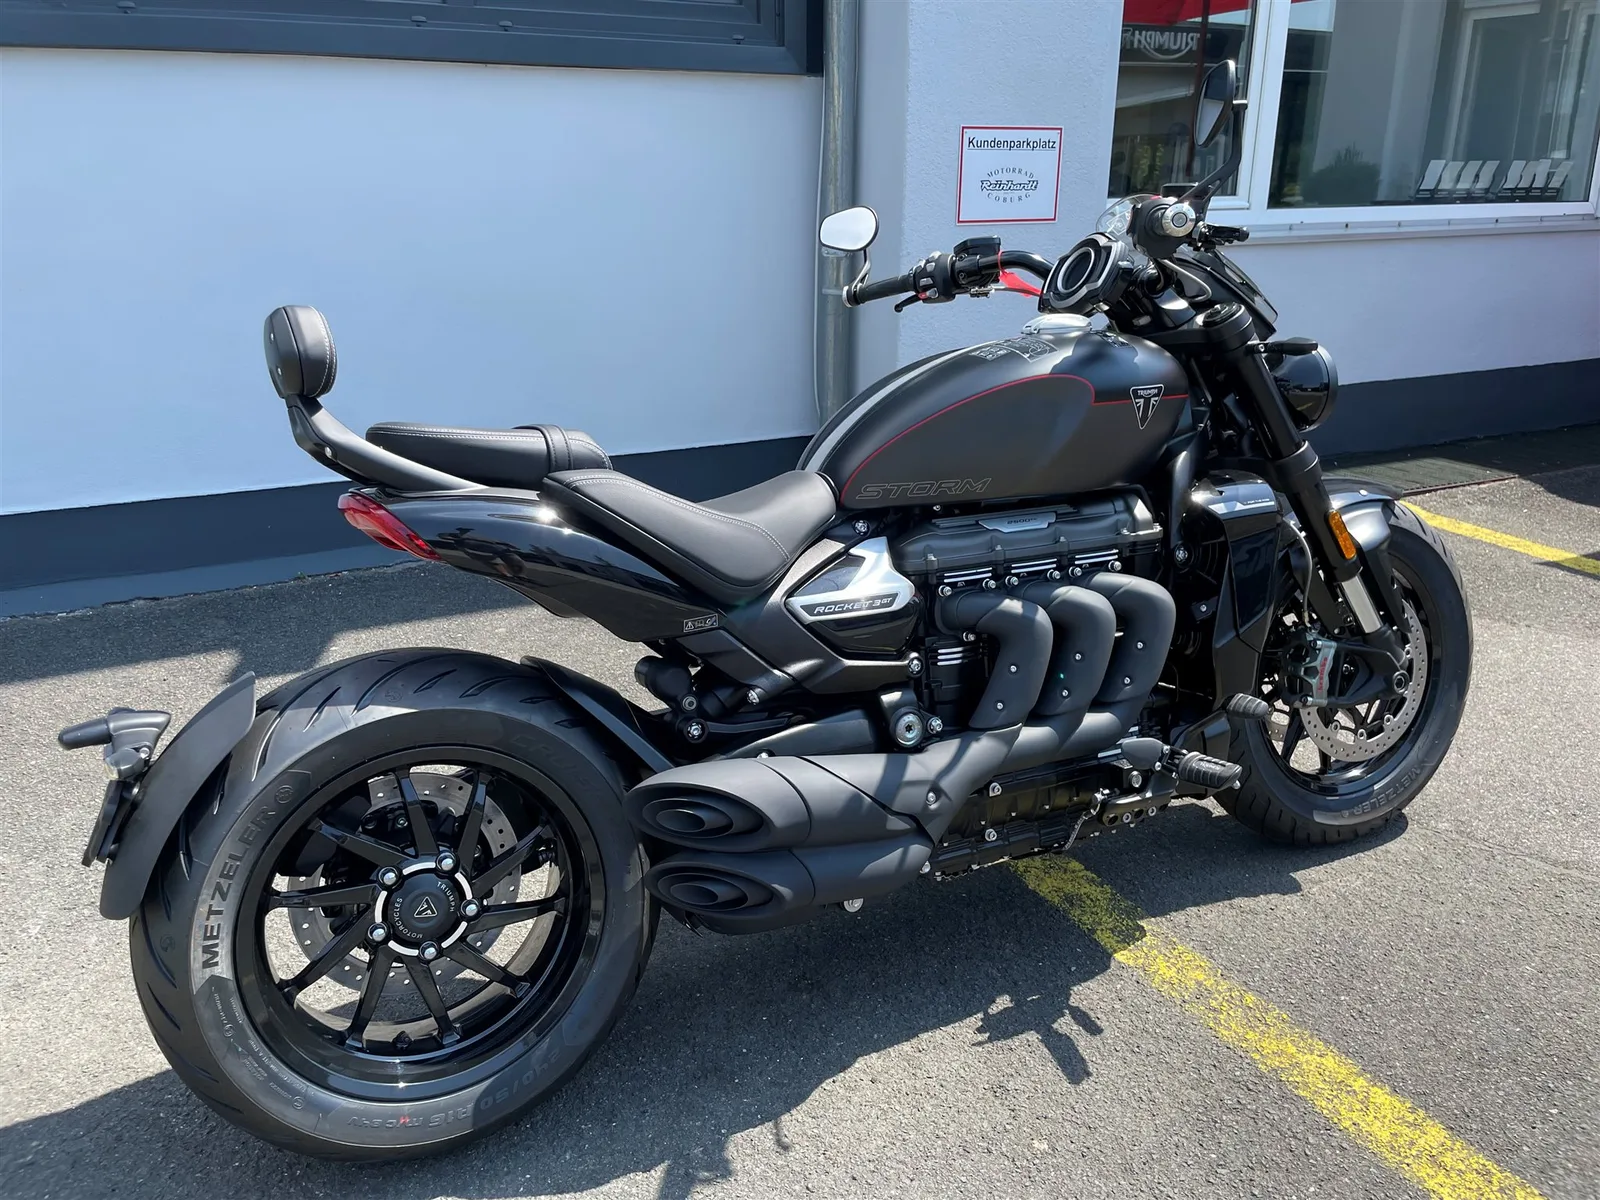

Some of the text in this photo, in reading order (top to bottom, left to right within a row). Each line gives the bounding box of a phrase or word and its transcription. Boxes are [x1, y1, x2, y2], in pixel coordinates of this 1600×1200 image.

[968, 136, 1056, 151] Kundenparkplatz
[987, 167, 1035, 179] MOTORRAD
[980, 179, 1039, 192] Reinhardt
[987, 192, 1031, 203] COBURG
[855, 478, 992, 500] STORM
[813, 600, 873, 614] ROCKET
[1353, 765, 1421, 815] METZELER
[202, 805, 276, 970] METZELER
[437, 881, 456, 912] TRIUMPH
[393, 897, 424, 939] MOTORCYCLES
